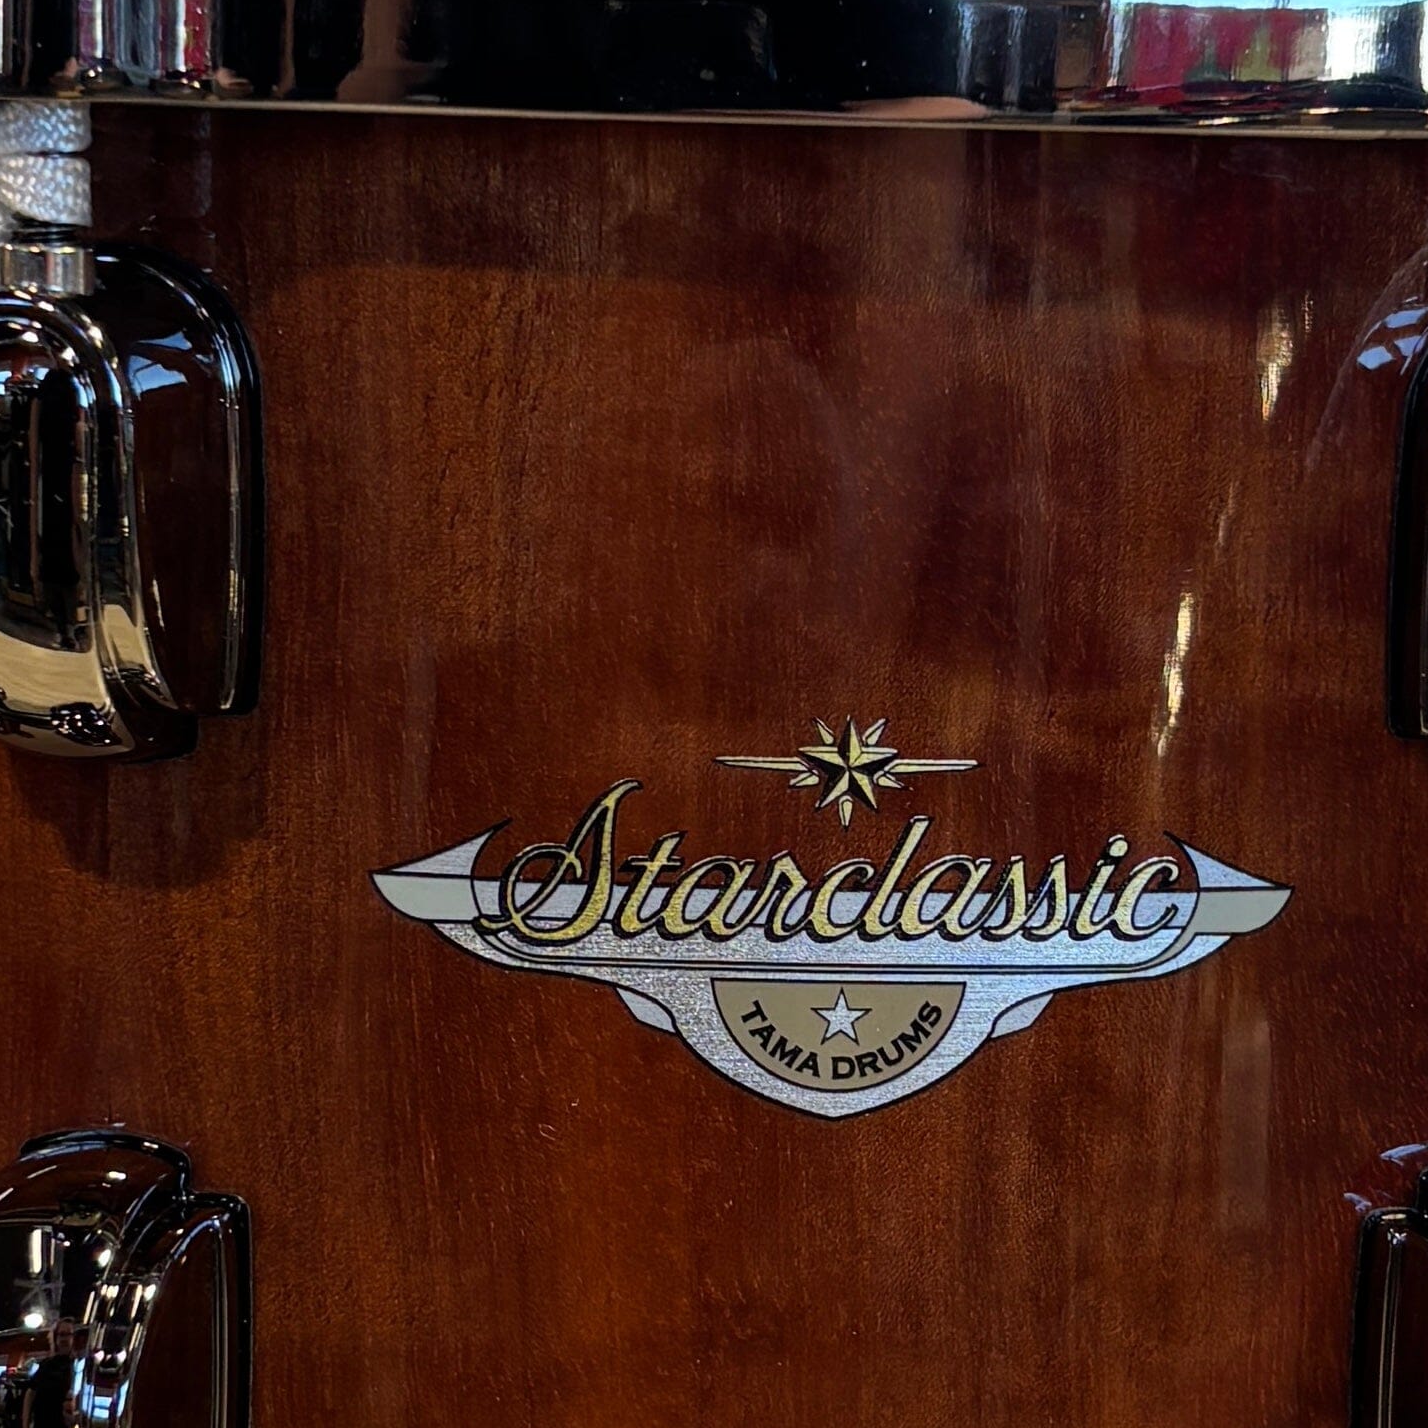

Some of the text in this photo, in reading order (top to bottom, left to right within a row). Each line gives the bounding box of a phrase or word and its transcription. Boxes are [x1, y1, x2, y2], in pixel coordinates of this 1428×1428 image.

[474, 778, 1180, 943] Starclassic
[740, 1000, 943, 1080] TAMA DRUMS
